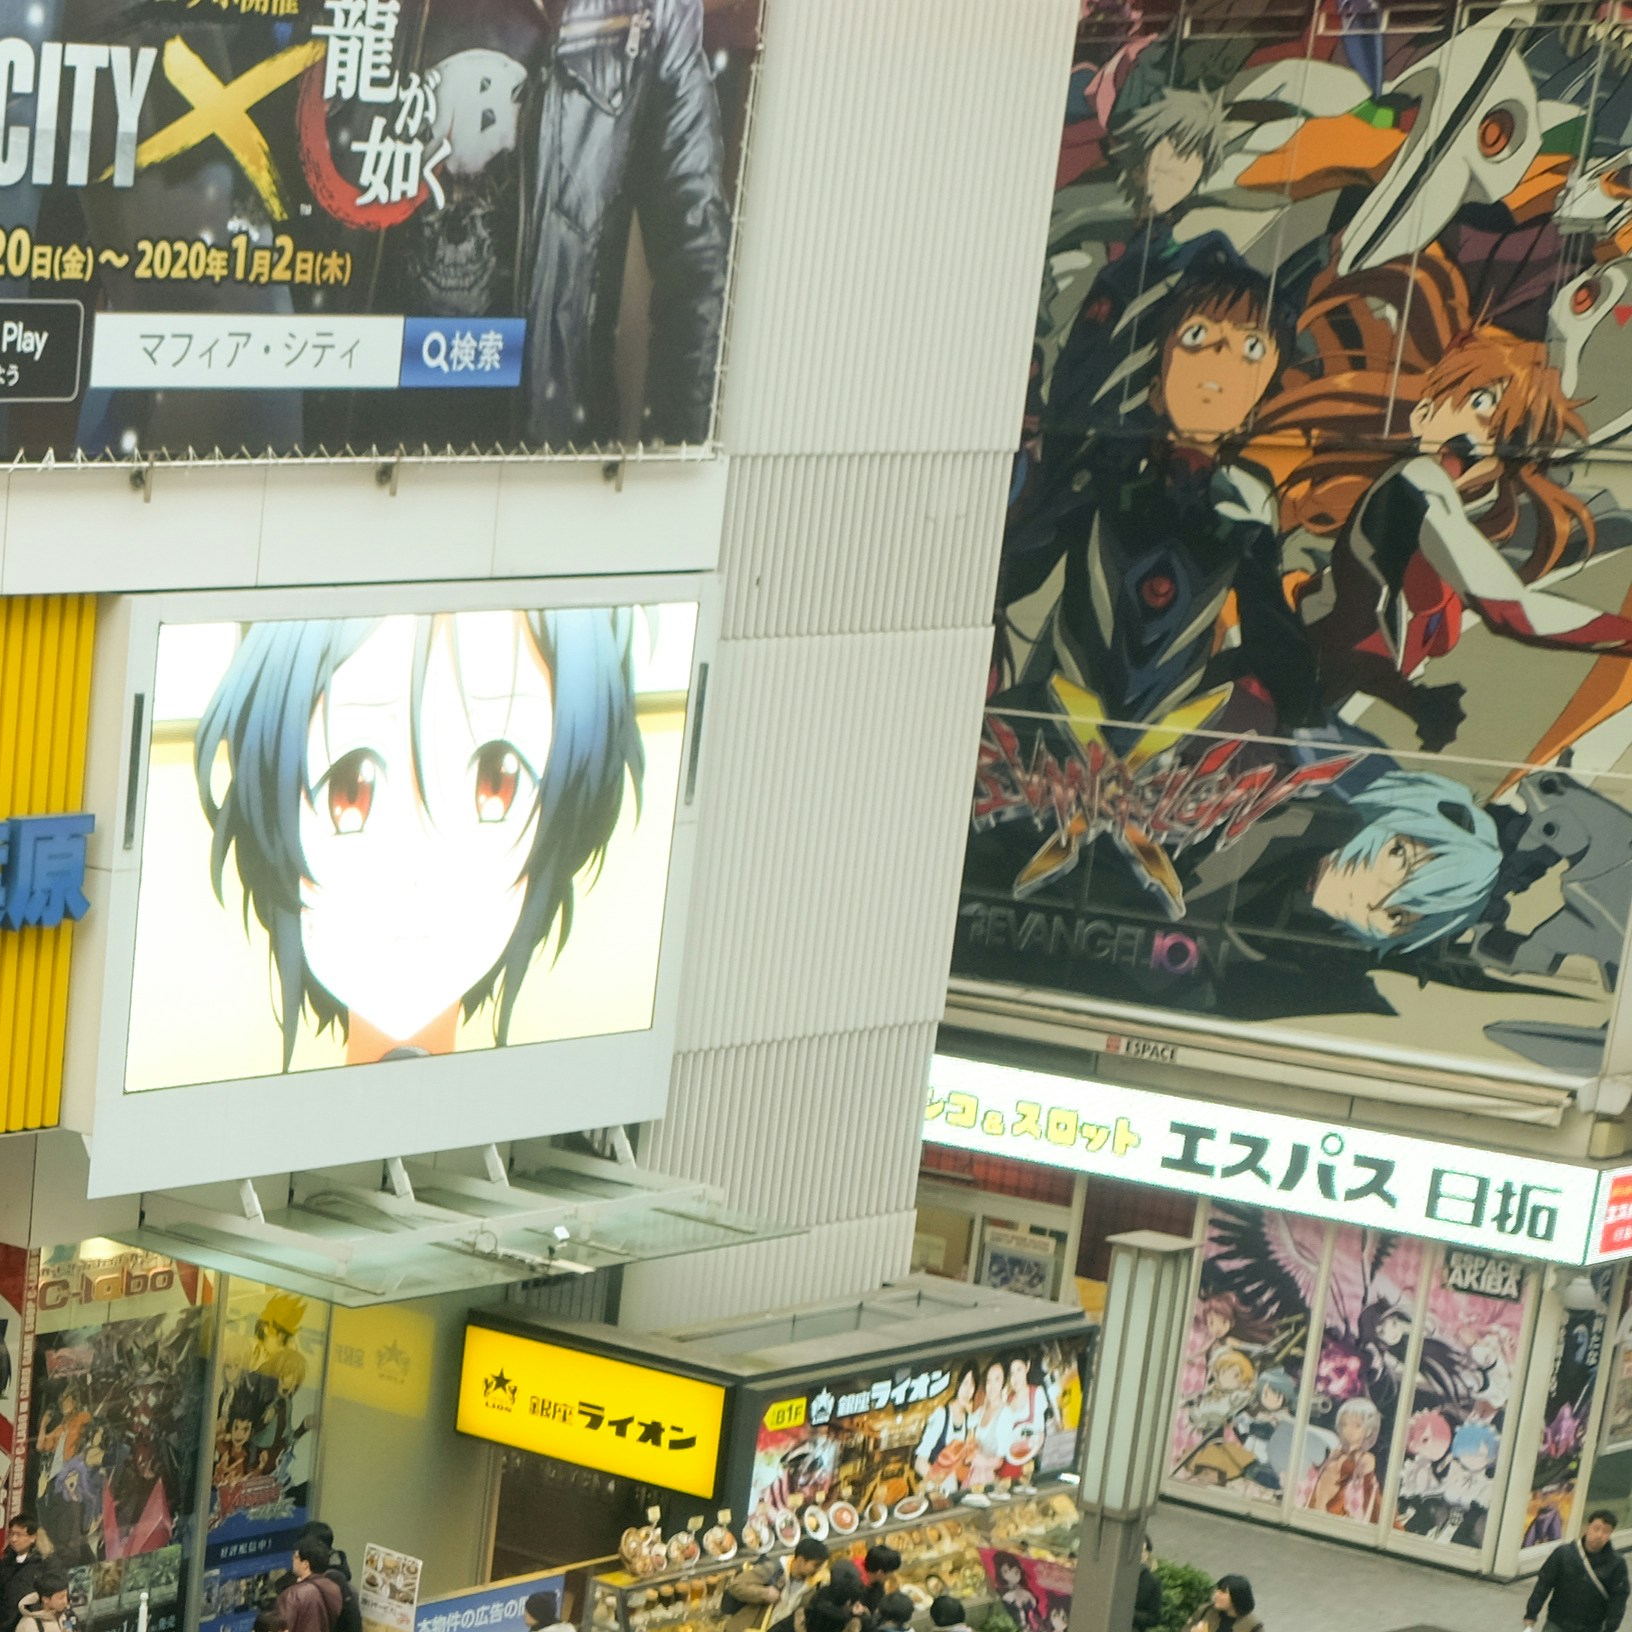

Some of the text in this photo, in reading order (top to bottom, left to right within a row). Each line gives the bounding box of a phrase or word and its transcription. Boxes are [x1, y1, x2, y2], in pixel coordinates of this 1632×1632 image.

[2, 320, 48, 361] Play
[138, 331, 504, 373] マフィア・シティ 検索
[1125, 1039, 1178, 1062] ESPACE
[1160, 1120, 1400, 1209] エスパス
[1447, 1267, 1520, 1299] AKIBA
[1450, 1252, 1524, 1282] ESPACE
[837, 1369, 950, 1418] 銀座ライオン
[528, 1395, 697, 1452] 銀座ライオン
[774, 1403, 804, 1426] B1F
